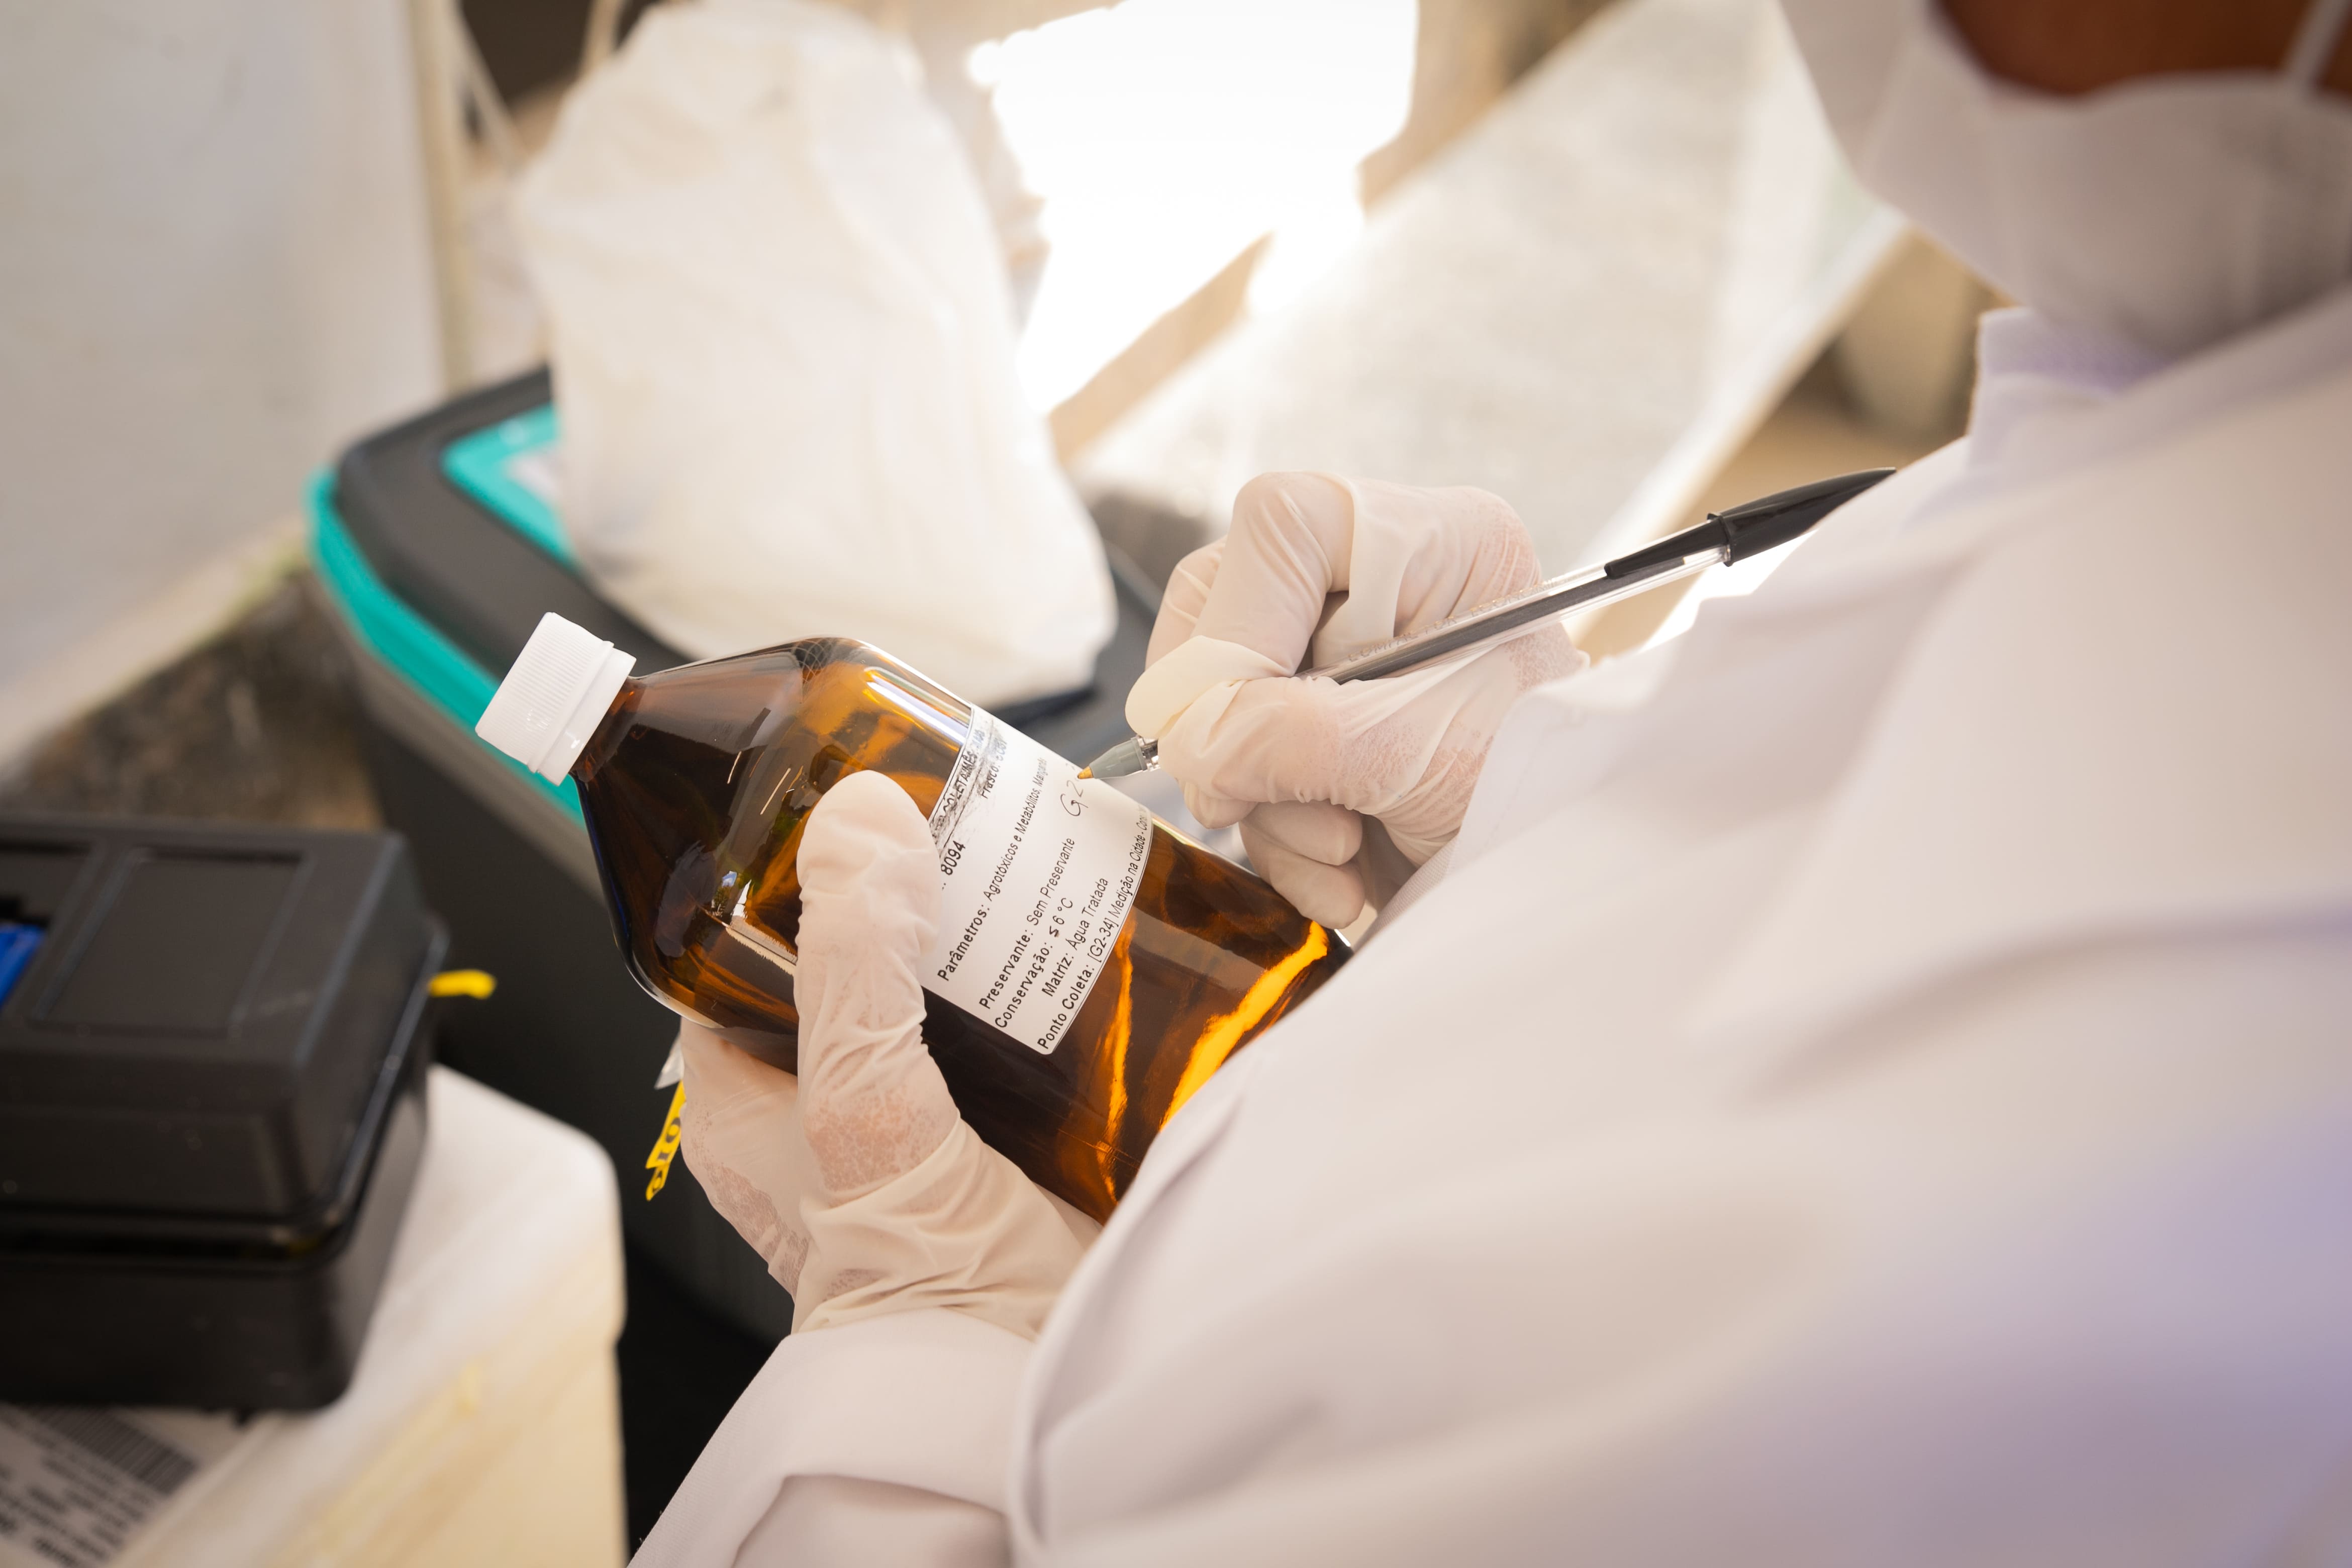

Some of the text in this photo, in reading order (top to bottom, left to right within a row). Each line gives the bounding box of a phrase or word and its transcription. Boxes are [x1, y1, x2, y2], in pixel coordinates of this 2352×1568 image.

[1015, 788, 1042, 835] Metabólitos,
[941, 841, 965, 875] 8094
[1013, 834, 1022, 842] e
[1129, 835, 1145, 862] Cidade
[983, 843, 1018, 901] Agrotóxicos
[1128, 862, 1138, 876] na
[1108, 876, 1134, 918] Medição
[937, 904, 990, 981] Parâmetros:
[979, 838, 1075, 1009] Preservante: Sem Preservante
[1041, 877, 1109, 997] Matriz: Água Tratada
[1088, 918, 1119, 963] [G2-34]
[995, 942, 1053, 1028] Conservação:
[1052, 915, 1064, 925] 6
[1062, 965, 1094, 1010] Coleta:
[1037, 1013, 1067, 1049] Ponto
